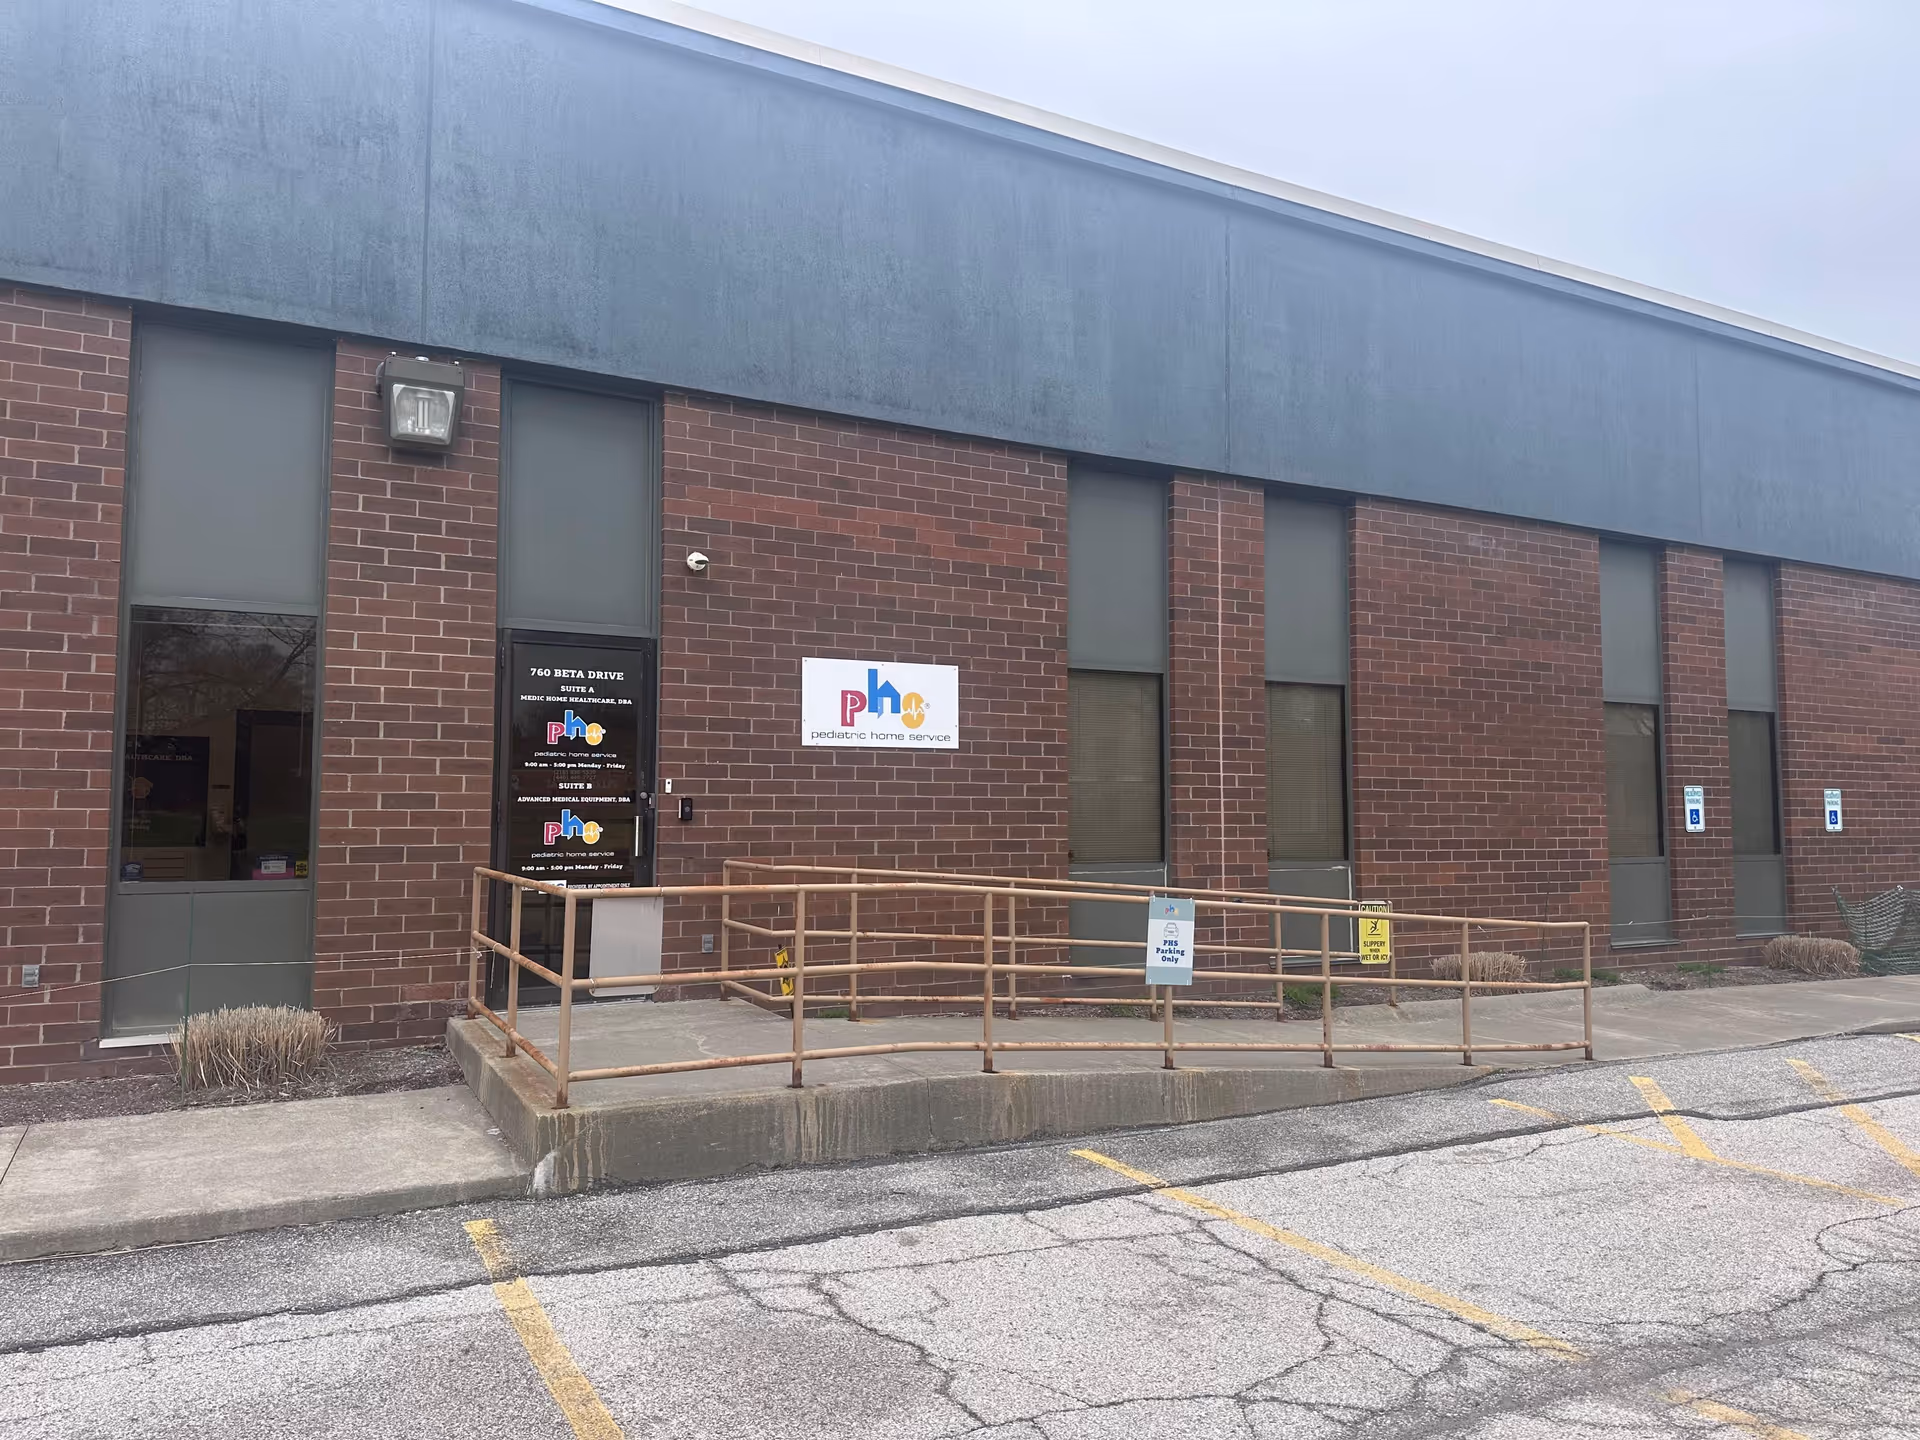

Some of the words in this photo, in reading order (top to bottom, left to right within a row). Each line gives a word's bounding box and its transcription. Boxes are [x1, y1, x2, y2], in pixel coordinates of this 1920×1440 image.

[530, 668, 551, 677] 760
[554, 669, 584, 678] BETA
[588, 670, 624, 680] DRIVE
[569, 696, 616, 704] HEALTHCARE,
[811, 730, 866, 740] pediatric
[870, 730, 904, 740] home
[908, 732, 950, 742] service
[1156, 948, 1185, 956] Parking
[1162, 956, 1179, 964] Only
